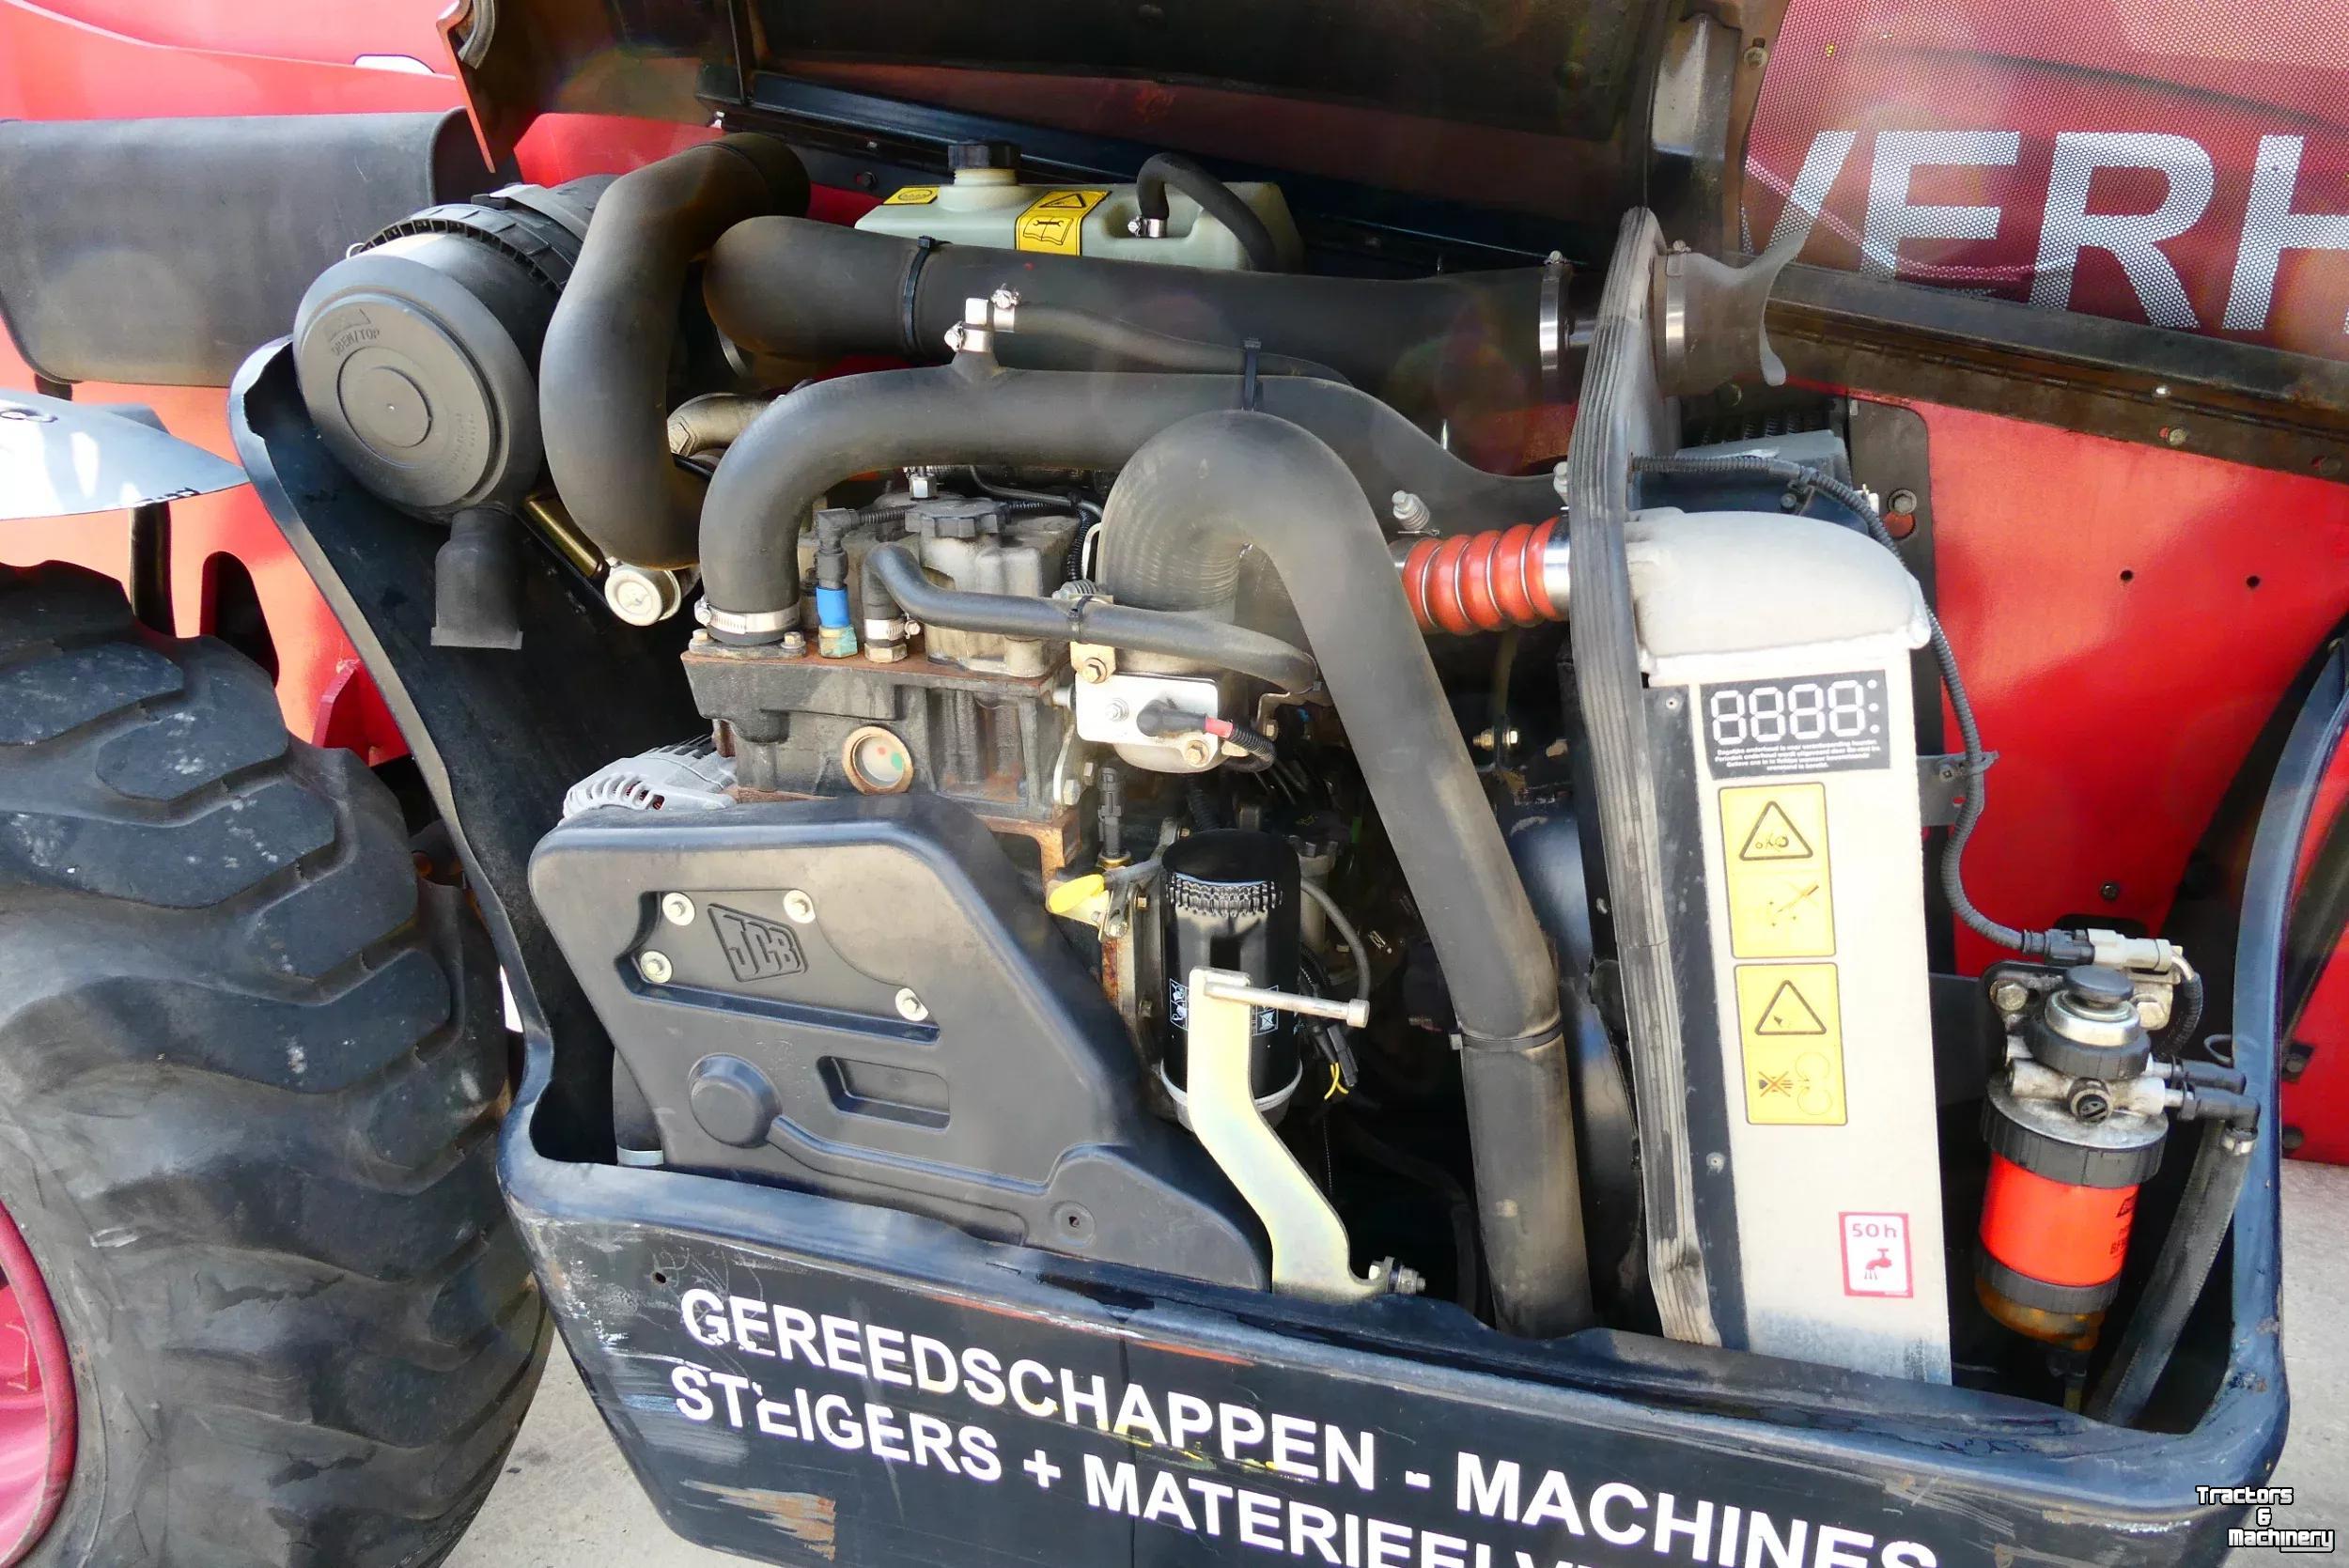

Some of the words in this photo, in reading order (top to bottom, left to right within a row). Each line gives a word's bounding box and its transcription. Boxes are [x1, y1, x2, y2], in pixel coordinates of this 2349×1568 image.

[722, 913, 801, 975] JCB
[671, 1365, 1003, 1483] STEIGERS
[1023, 1449, 1061, 1488] +
[1082, 1452, 1594, 1568] MATERIEE
[680, 1288, 1375, 1490] GEREEDSCHAPPEN
